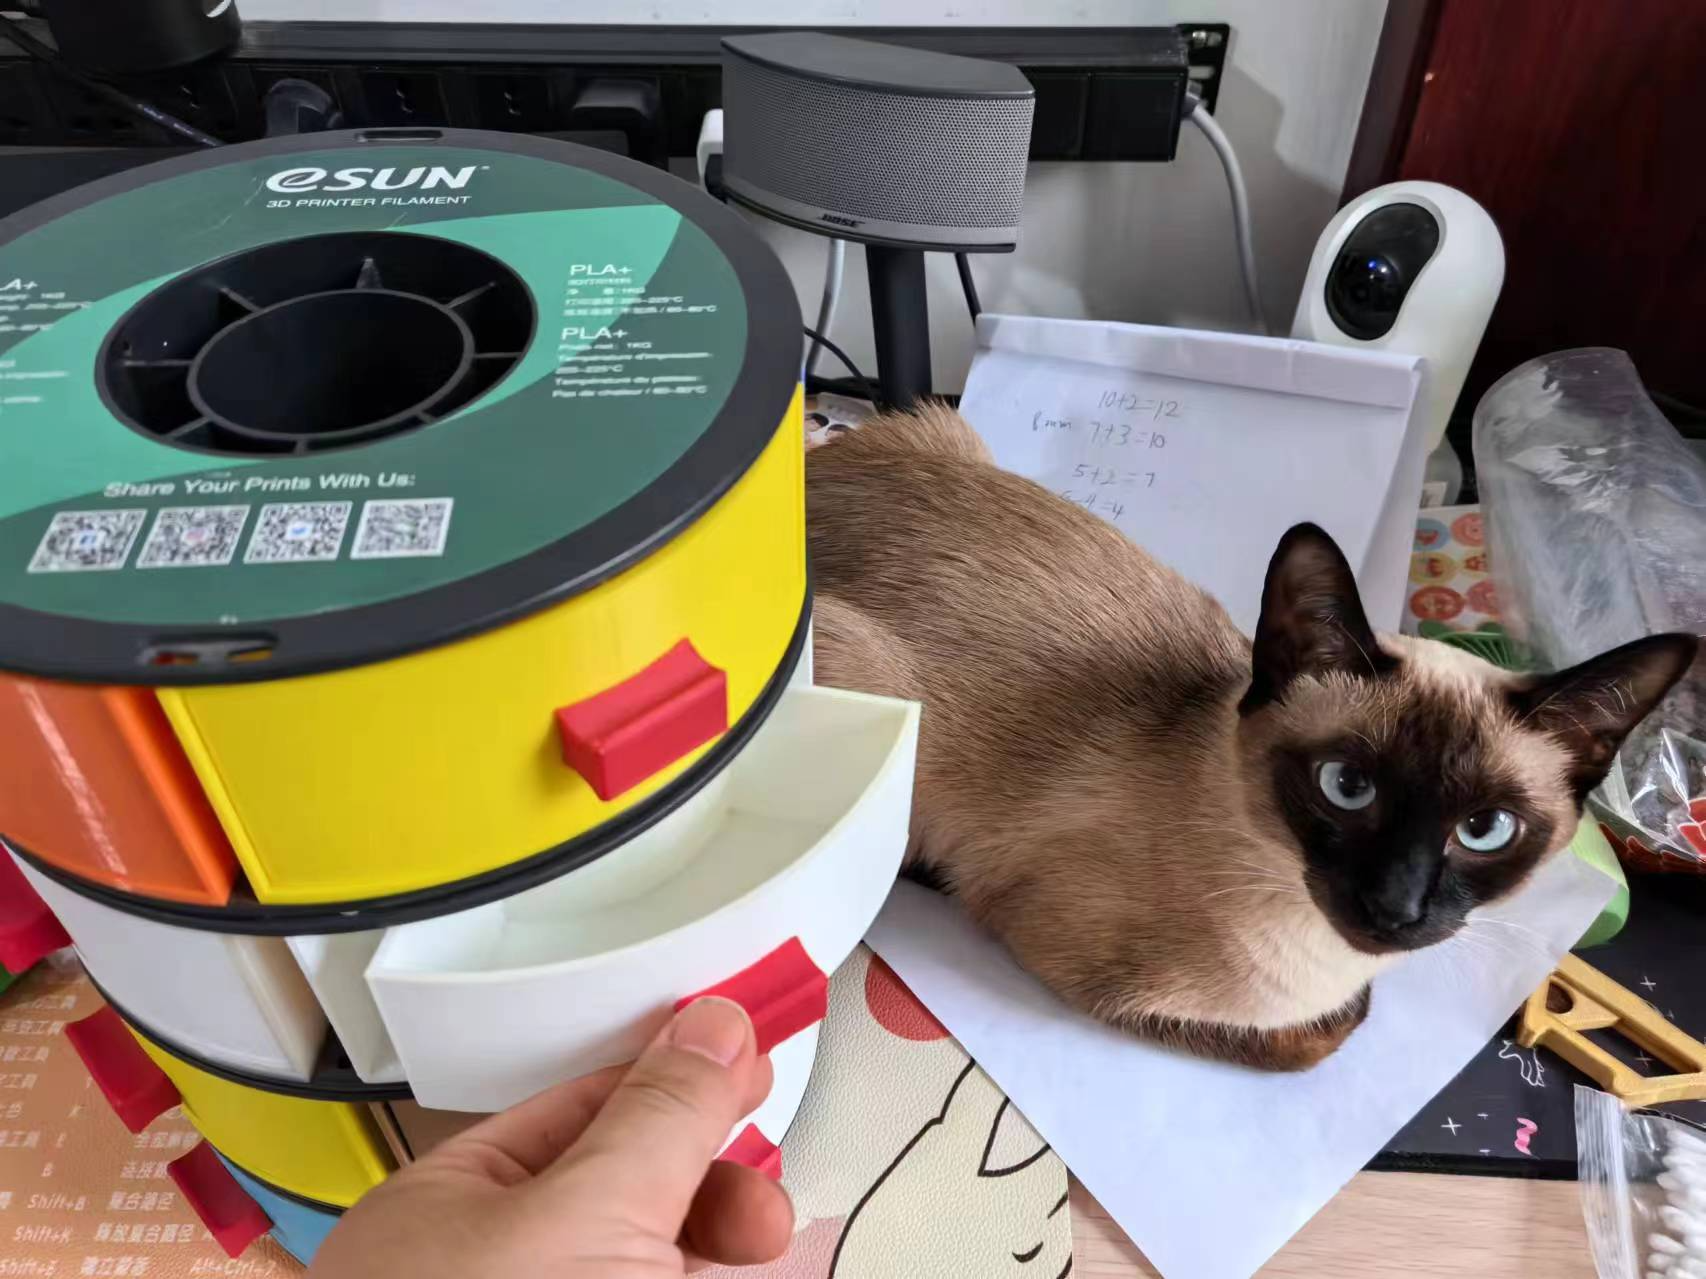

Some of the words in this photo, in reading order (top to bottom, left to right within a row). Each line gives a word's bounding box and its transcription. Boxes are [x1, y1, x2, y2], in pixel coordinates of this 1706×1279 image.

[266, 199, 291, 208] 3D
[296, 197, 376, 207] PRINTER
[380, 195, 472, 206] FILAMENT
[570, 264, 632, 276] PLA+
[0, 278, 38, 291] A+
[561, 326, 628, 340] PLA+
[104, 481, 175, 498] Share
[184, 477, 240, 494] Your
[243, 474, 311, 491] Prints
[318, 472, 371, 489] With
[376, 471, 417, 487] Us:
